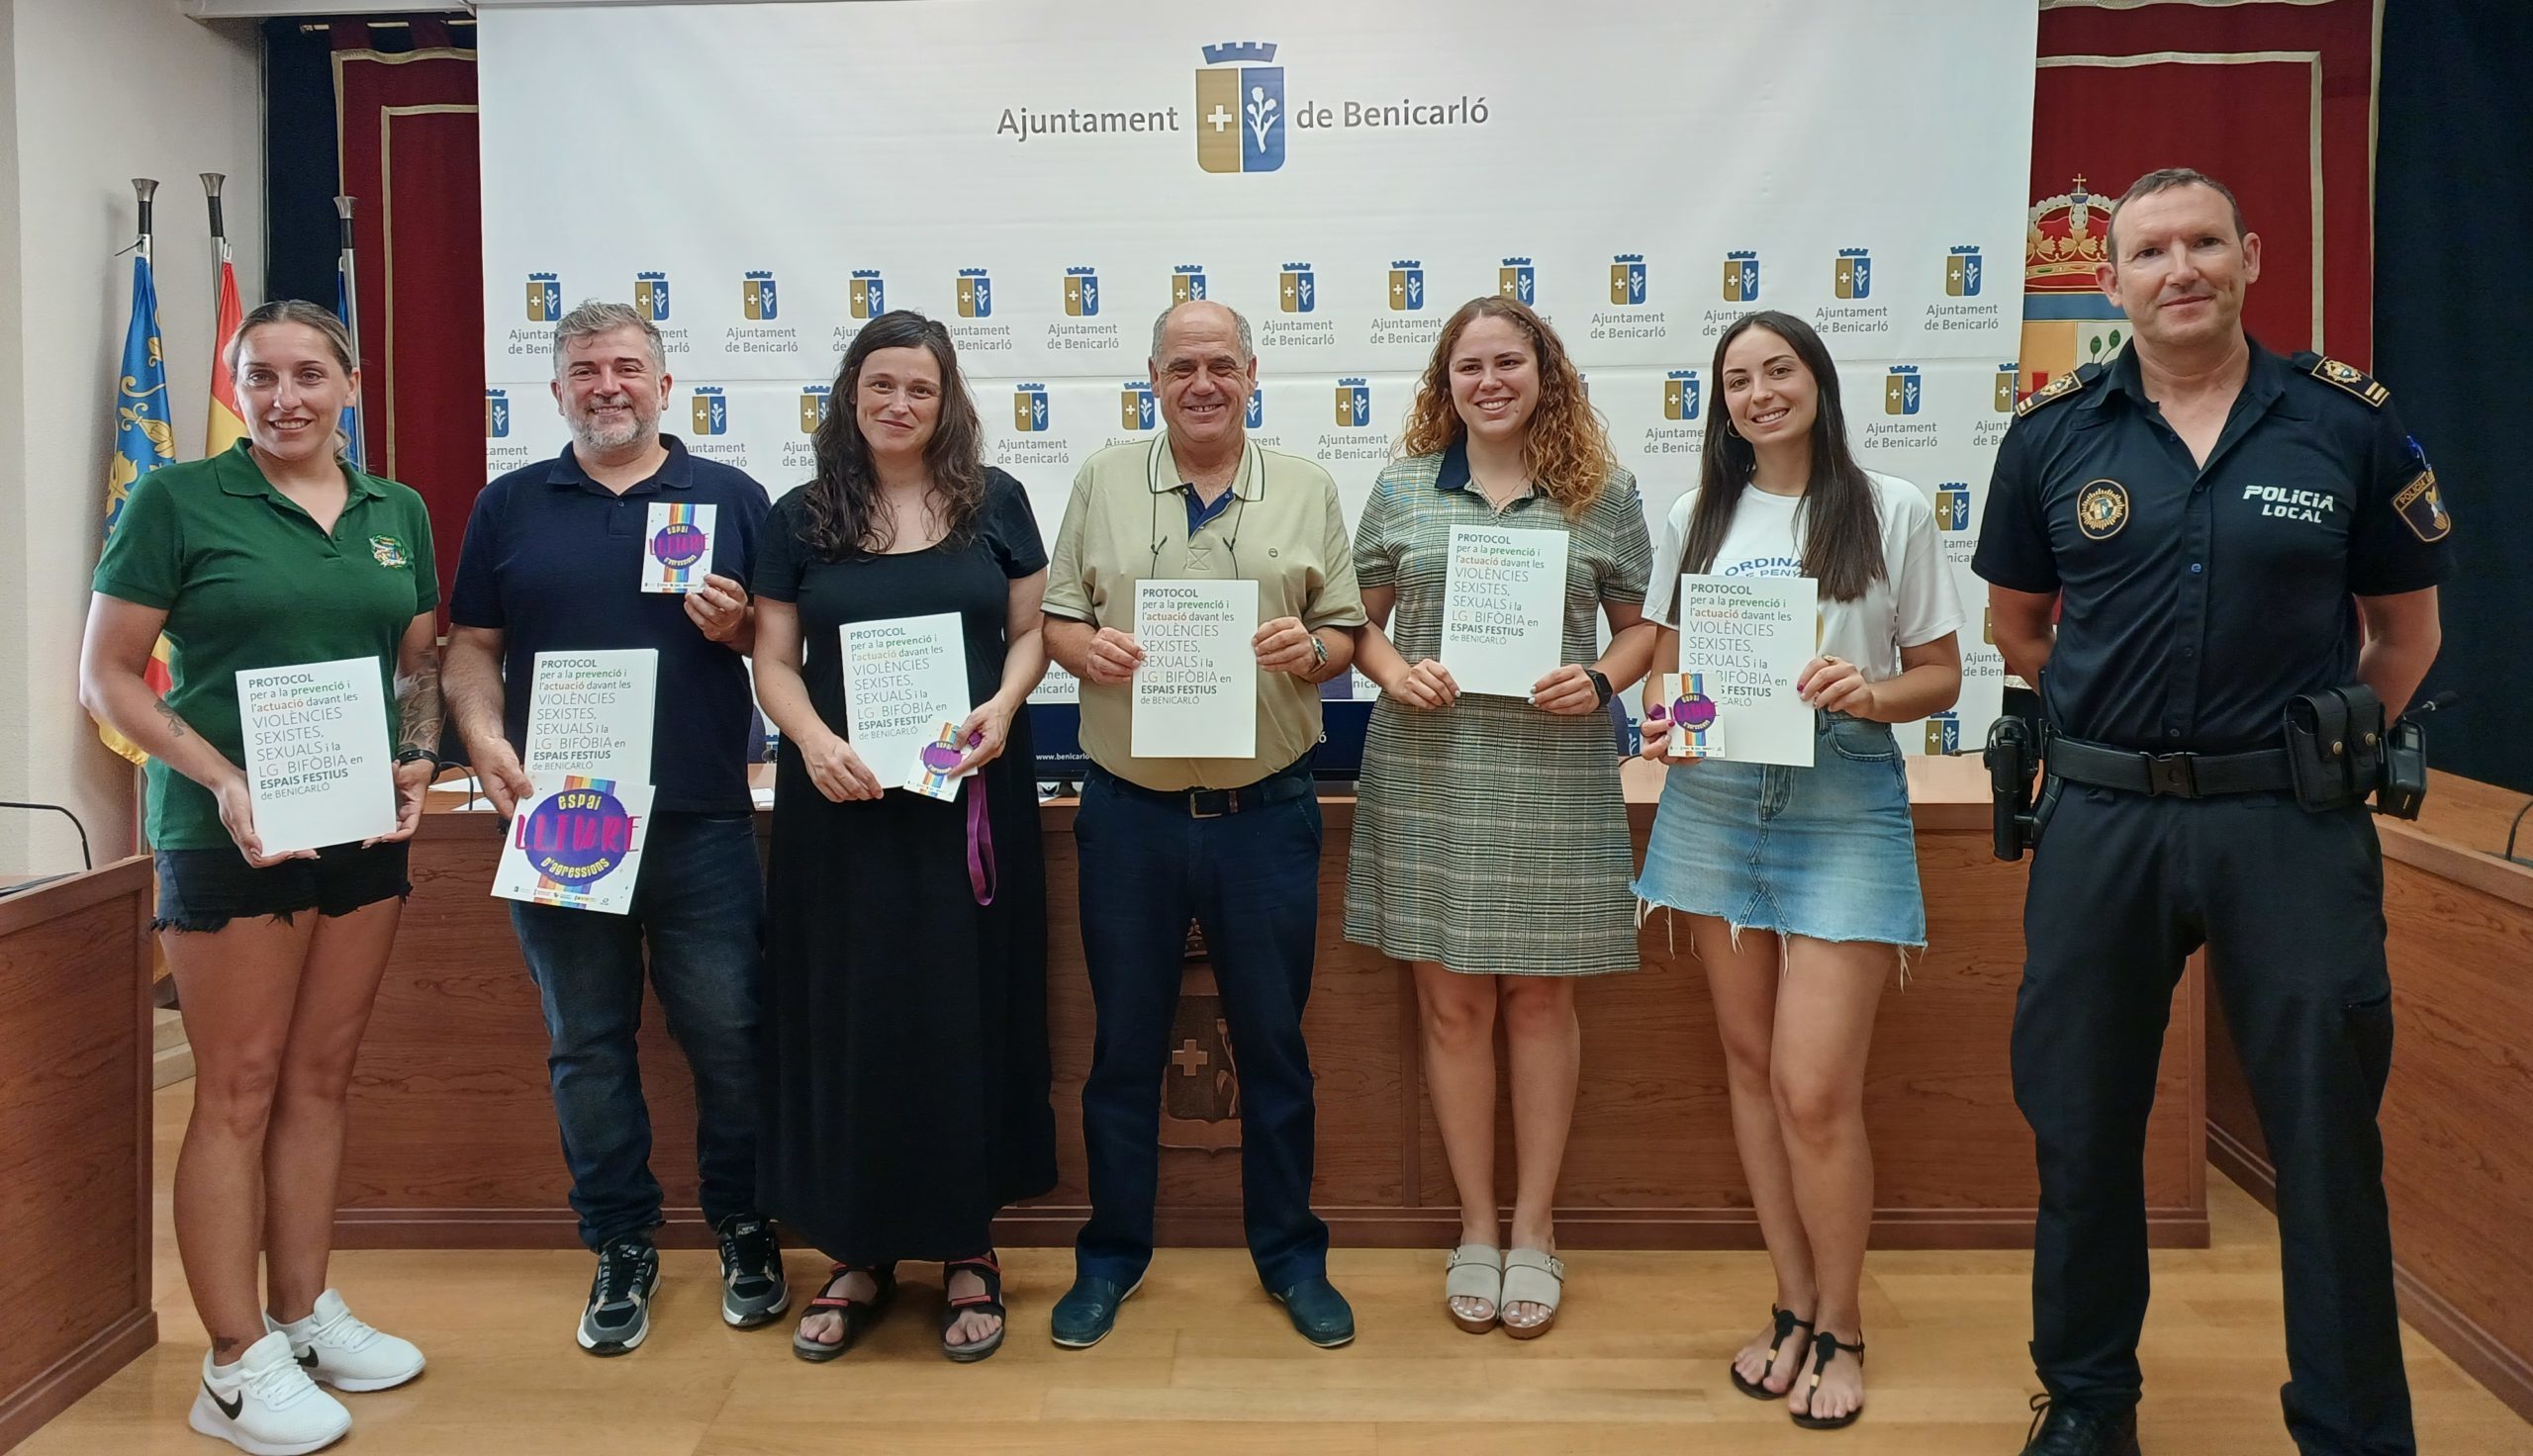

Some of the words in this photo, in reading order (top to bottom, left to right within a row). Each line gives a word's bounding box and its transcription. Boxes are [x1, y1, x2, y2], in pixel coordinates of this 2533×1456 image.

[997, 107, 1178, 140] Ajuntament
[1296, 102, 1334, 131] de
[1343, 96, 1489, 129] Benicarló
[1816, 306, 1887, 319] Ajuntament
[1926, 304, 1998, 318] Ajuntament
[1263, 318, 1333, 332] Ajuntament
[1371, 318, 1442, 331] Ajuntament
[1591, 312, 1665, 325] Ajuntament
[1924, 319, 1939, 331] de
[1942, 318, 1999, 331] Benicarló
[726, 326, 797, 340] Ajuntament
[950, 324, 1010, 338] juntament
[1048, 323, 1118, 336] Ajuntament
[1590, 326, 1606, 339] de
[1609, 325, 1666, 338] Benicarló
[1815, 321, 1829, 333] de
[1831, 320, 1888, 333] Benicarló
[510, 328, 555, 341] Ajunta
[1262, 333, 1276, 345] de
[1279, 332, 1335, 345] Benicarló
[1370, 332, 1385, 344] de
[725, 341, 740, 353] de
[742, 340, 797, 353] Benicarló
[958, 337, 1012, 350] Benicarló
[1047, 337, 1062, 349] de
[1065, 336, 1119, 349] Benicarló
[1645, 427, 1704, 441] Ajuntame
[1866, 422, 1936, 435] Ajuntament
[998, 438, 1068, 451] Ajuntament
[1318, 433, 1388, 447] Ajuntament
[1864, 437, 1879, 449] de
[1882, 436, 1937, 449] Benicarló
[1317, 448, 1332, 460] de
[1335, 447, 1389, 460] Benicarló
[1644, 441, 1659, 454] de
[1662, 442, 1702, 454] Benica
[997, 452, 1011, 465] de
[1014, 451, 1070, 464] Benicarló
[2262, 503, 2322, 524] LOCAL
[1457, 533, 1511, 545] PROTOCOL
[1456, 545, 1471, 554] per
[1480, 544, 1488, 554] la
[1490, 547, 1536, 559] prevenció
[1455, 555, 1499, 566] l'actuació
[1500, 558, 1530, 568] davant
[1533, 559, 1545, 569] les
[1455, 567, 1529, 583] VIOLÈNCIES
[1143, 589, 1198, 598] PROTOCOL
[1454, 582, 1510, 596] SEXISTES,
[1690, 584, 1752, 595] PROTOCOL
[1142, 600, 1157, 611] per
[1167, 599, 1174, 609] la
[1177, 599, 1224, 611] prevenció
[1453, 596, 1507, 610] SEXUALS
[1514, 601, 1522, 611] la
[1690, 596, 1706, 606] per
[1717, 595, 1726, 605] la
[1729, 596, 1780, 609] prevenció
[1142, 612, 1187, 621] l'actuació
[1188, 612, 1219, 621] davant
[1222, 612, 1235, 622] les
[1690, 607, 1738, 619] l'actuació
[1741, 610, 1775, 621] davant
[1777, 611, 1792, 622] les
[1528, 618, 1539, 627] en
[1689, 620, 1774, 637] VIOLÈNCIES
[850, 627, 905, 640] PROTOCOL
[1142, 622, 1219, 637] VIOLÈNCIES
[1451, 623, 1483, 634] ESPAIS
[1485, 625, 1524, 636] FESTIUS
[851, 642, 866, 653] per
[876, 639, 884, 648] la
[886, 635, 932, 649] prevenció
[1460, 634, 1507, 645] BENICARLÓ
[1689, 637, 1753, 653] SEXISTES,
[1142, 640, 1200, 653] SEXISTES,
[852, 650, 896, 662] l'actuació
[898, 647, 929, 658] davant
[931, 645, 943, 654] les
[541, 658, 598, 670] PROTOCOL
[853, 658, 930, 677] VIOLÈNCIES
[1142, 655, 1198, 668] SEXUALS
[1205, 658, 1213, 668] la
[1689, 653, 1750, 669] SEXUALS
[1758, 659, 1768, 670] la
[248, 674, 314, 688] PROTOCOL
[540, 671, 555, 681] per
[565, 670, 573, 680] la
[575, 668, 621, 681] prevenció
[539, 681, 585, 690] l'actuació
[586, 680, 616, 690] davant
[618, 680, 631, 689] les
[854, 675, 914, 691] SEXISTES,
[1034, 682, 1076, 694] nicarló
[1775, 678, 1787, 686] en
[250, 691, 266, 702] per
[279, 687, 288, 697] la
[291, 682, 344, 698] prevenció
[1141, 684, 1174, 694] ESPAIS
[1176, 684, 1217, 694] FESTIUS
[1728, 685, 1771, 697] FESTIUS
[251, 699, 304, 713] l'actuació
[306, 693, 341, 707] davant
[344, 692, 358, 703] les
[538, 690, 615, 706] VIOLÈNCIES
[856, 688, 912, 705] SEXUALS
[920, 689, 928, 699] la
[1141, 695, 1151, 705] de
[1153, 694, 1200, 705] BENICARLÓ
[1722, 696, 1752, 707] CARLÓ
[252, 706, 342, 729] VIOLÈNCIES
[536, 707, 597, 721] SEXISTES,
[535, 722, 594, 735] SEXUALS
[601, 724, 609, 734] la
[858, 718, 892, 731] ESPAIS
[254, 725, 324, 746] SEXISTES,
[859, 732, 869, 741] de
[871, 725, 918, 740] BENICARLÓ
[614, 740, 626, 749] en
[256, 742, 323, 762] SEXUALS
[331, 742, 341, 752] la
[533, 751, 569, 761] ESPAIS
[571, 750, 610, 761] FESTIUS
[350, 755, 363, 766] en
[532, 761, 542, 771] de
[545, 759, 594, 771] BENICARLÓ
[260, 774, 300, 790] ESPAIS
[303, 768, 348, 784] FESTIUS
[260, 790, 273, 801] de
[275, 782, 330, 799] BENICARLÓ
[557, 793, 603, 811] espai
